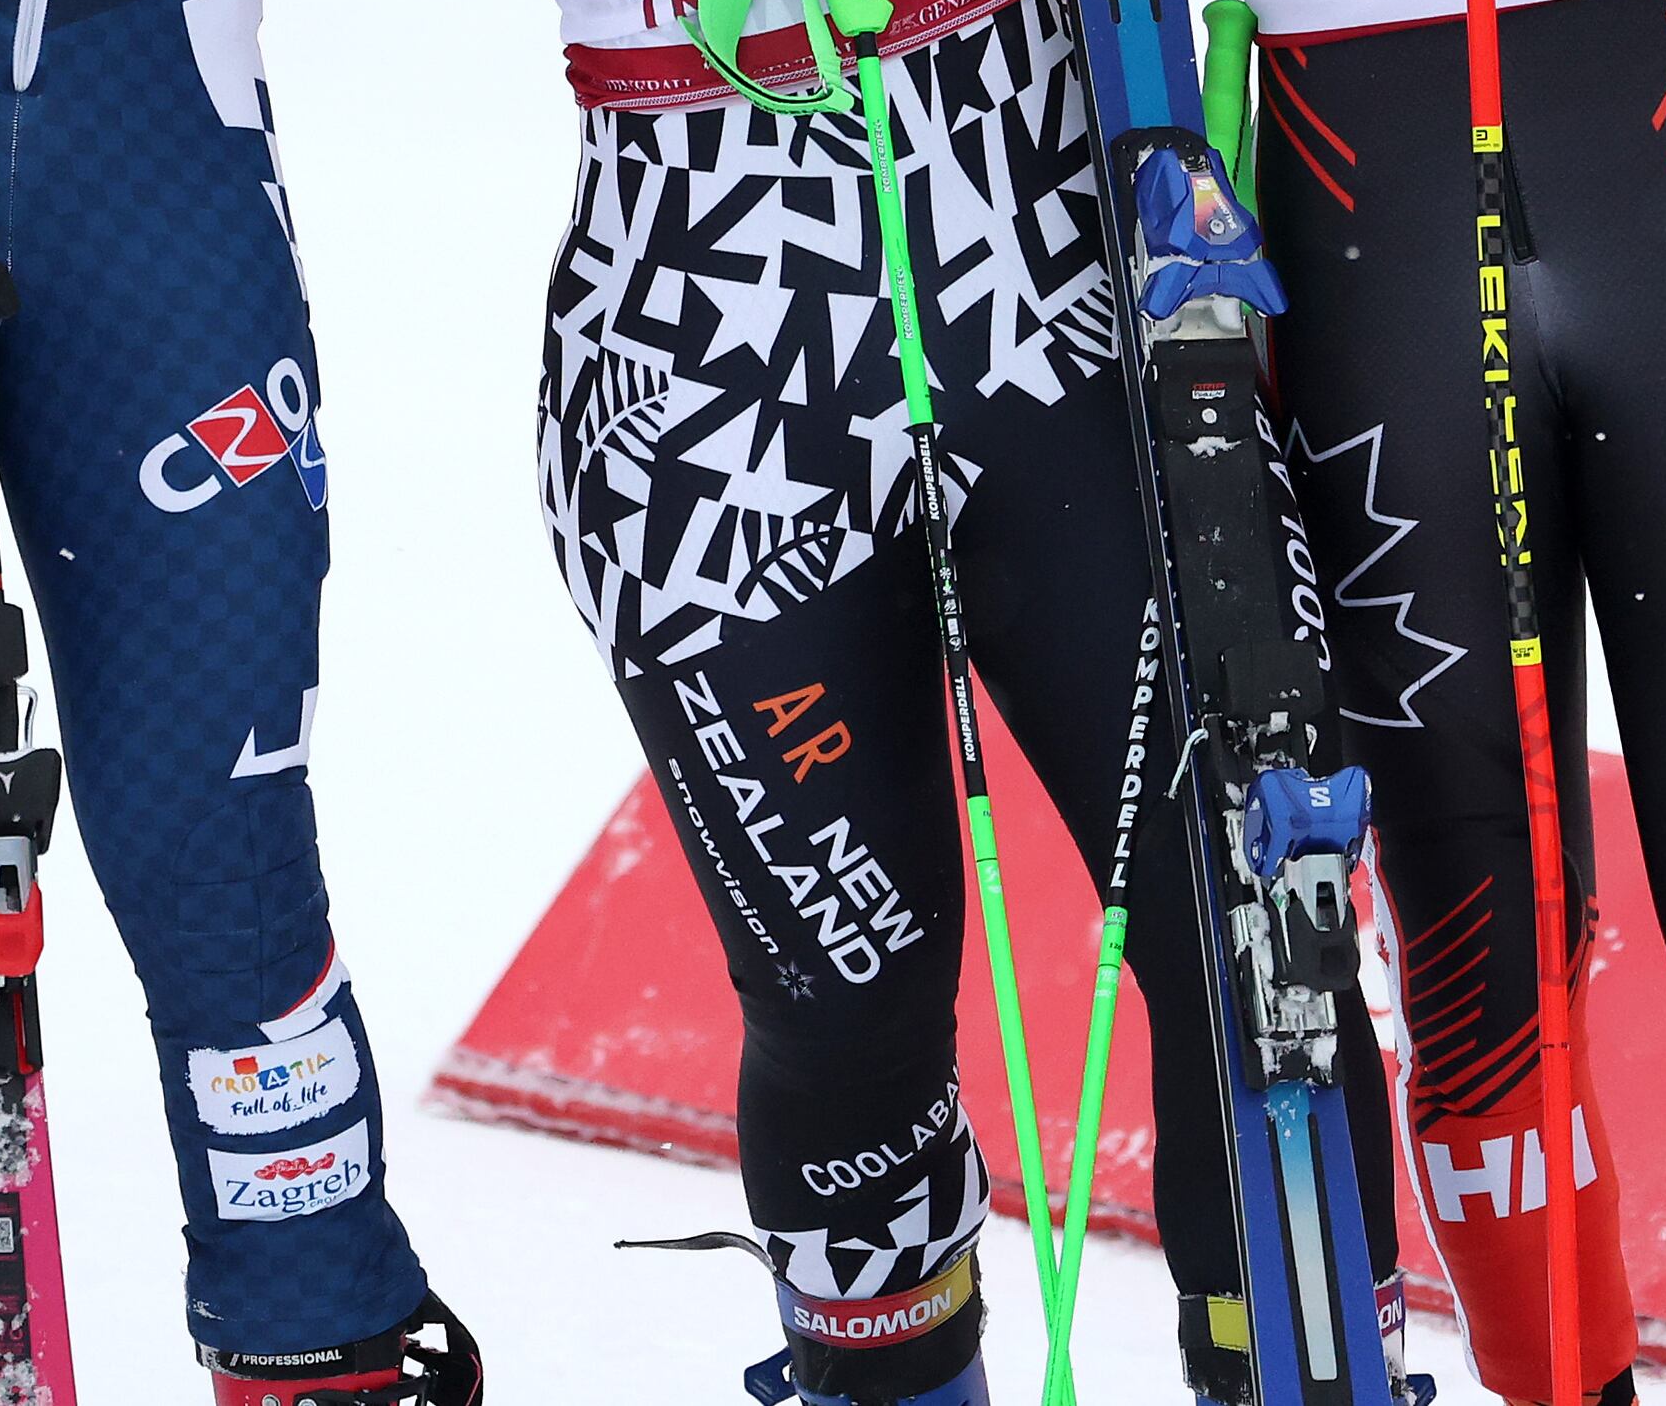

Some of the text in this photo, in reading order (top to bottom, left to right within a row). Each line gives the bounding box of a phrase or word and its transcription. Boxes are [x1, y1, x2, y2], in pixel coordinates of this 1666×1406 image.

[1476, 214, 1510, 384] LEKI
[919, 433, 941, 522] KOMPERDELL
[954, 675, 976, 763] KOMPERDELL
[1111, 597, 1160, 888] KOMPERDELL
[668, 757, 779, 954] snowvision
[673, 670, 882, 984] ZEALAND
[809, 816, 925, 953] NEW
[211, 1053, 336, 1094] CROATIA
[225, 1158, 361, 1213] Zagreb
[242, 1349, 343, 1366] PROFESSIONAL
[793, 1288, 952, 1340] SALOMON
